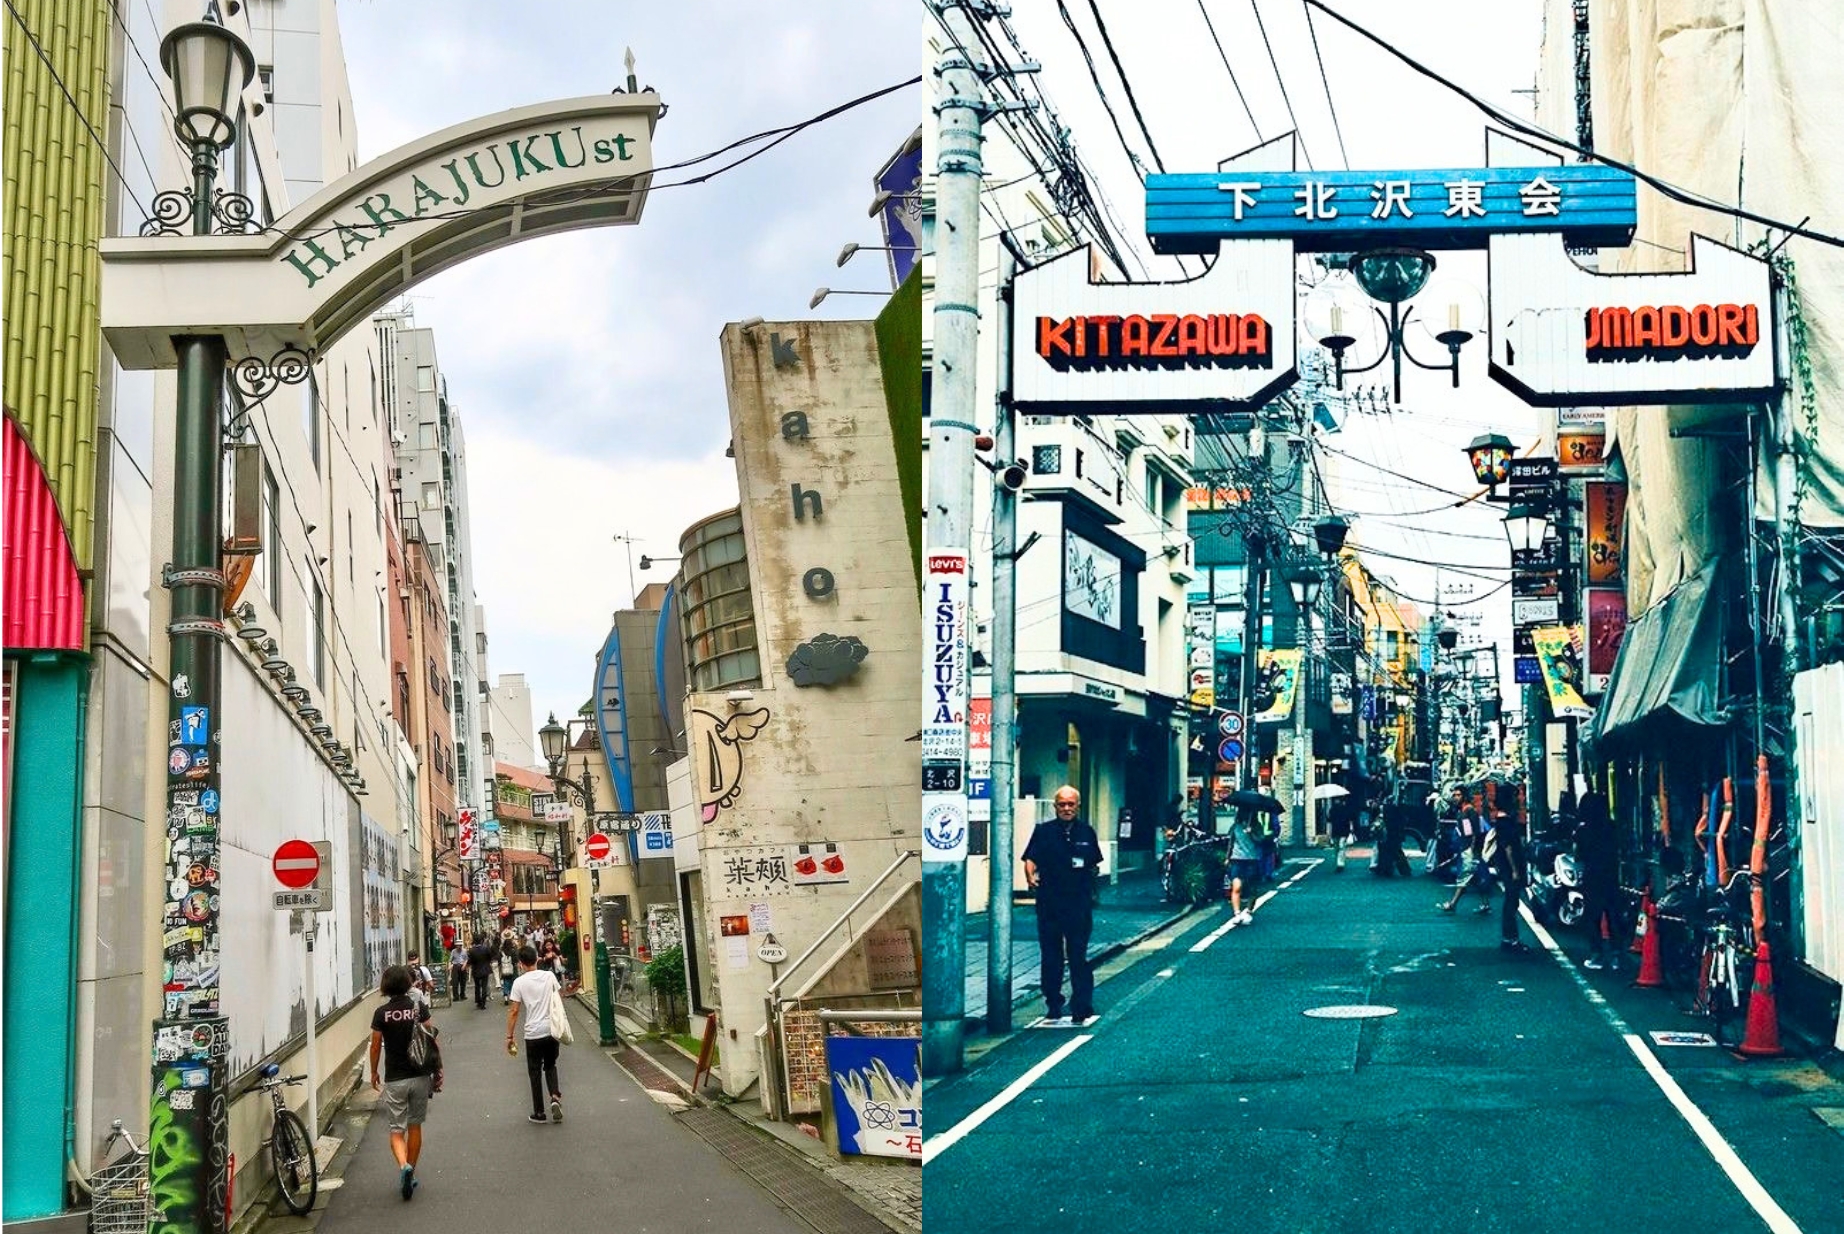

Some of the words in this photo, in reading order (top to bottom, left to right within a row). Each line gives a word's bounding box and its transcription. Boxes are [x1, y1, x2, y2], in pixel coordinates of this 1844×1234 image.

[1218, 176, 1563, 219] 下北沢東会
[281, 126, 586, 289] HARAJUKU
[593, 133, 636, 164] st
[1037, 312, 1270, 360] KITAZAWA
[933, 583, 955, 723] ISUZUYA
[1225, 718, 1239, 731] 30
[926, 779, 956, 789] 2-10
[276, 894, 318, 906] 自転車を除く
[760, 948, 784, 957] OPEN
[384, 1009, 417, 1023] FOR
[897, 1109, 923, 1129] コ
